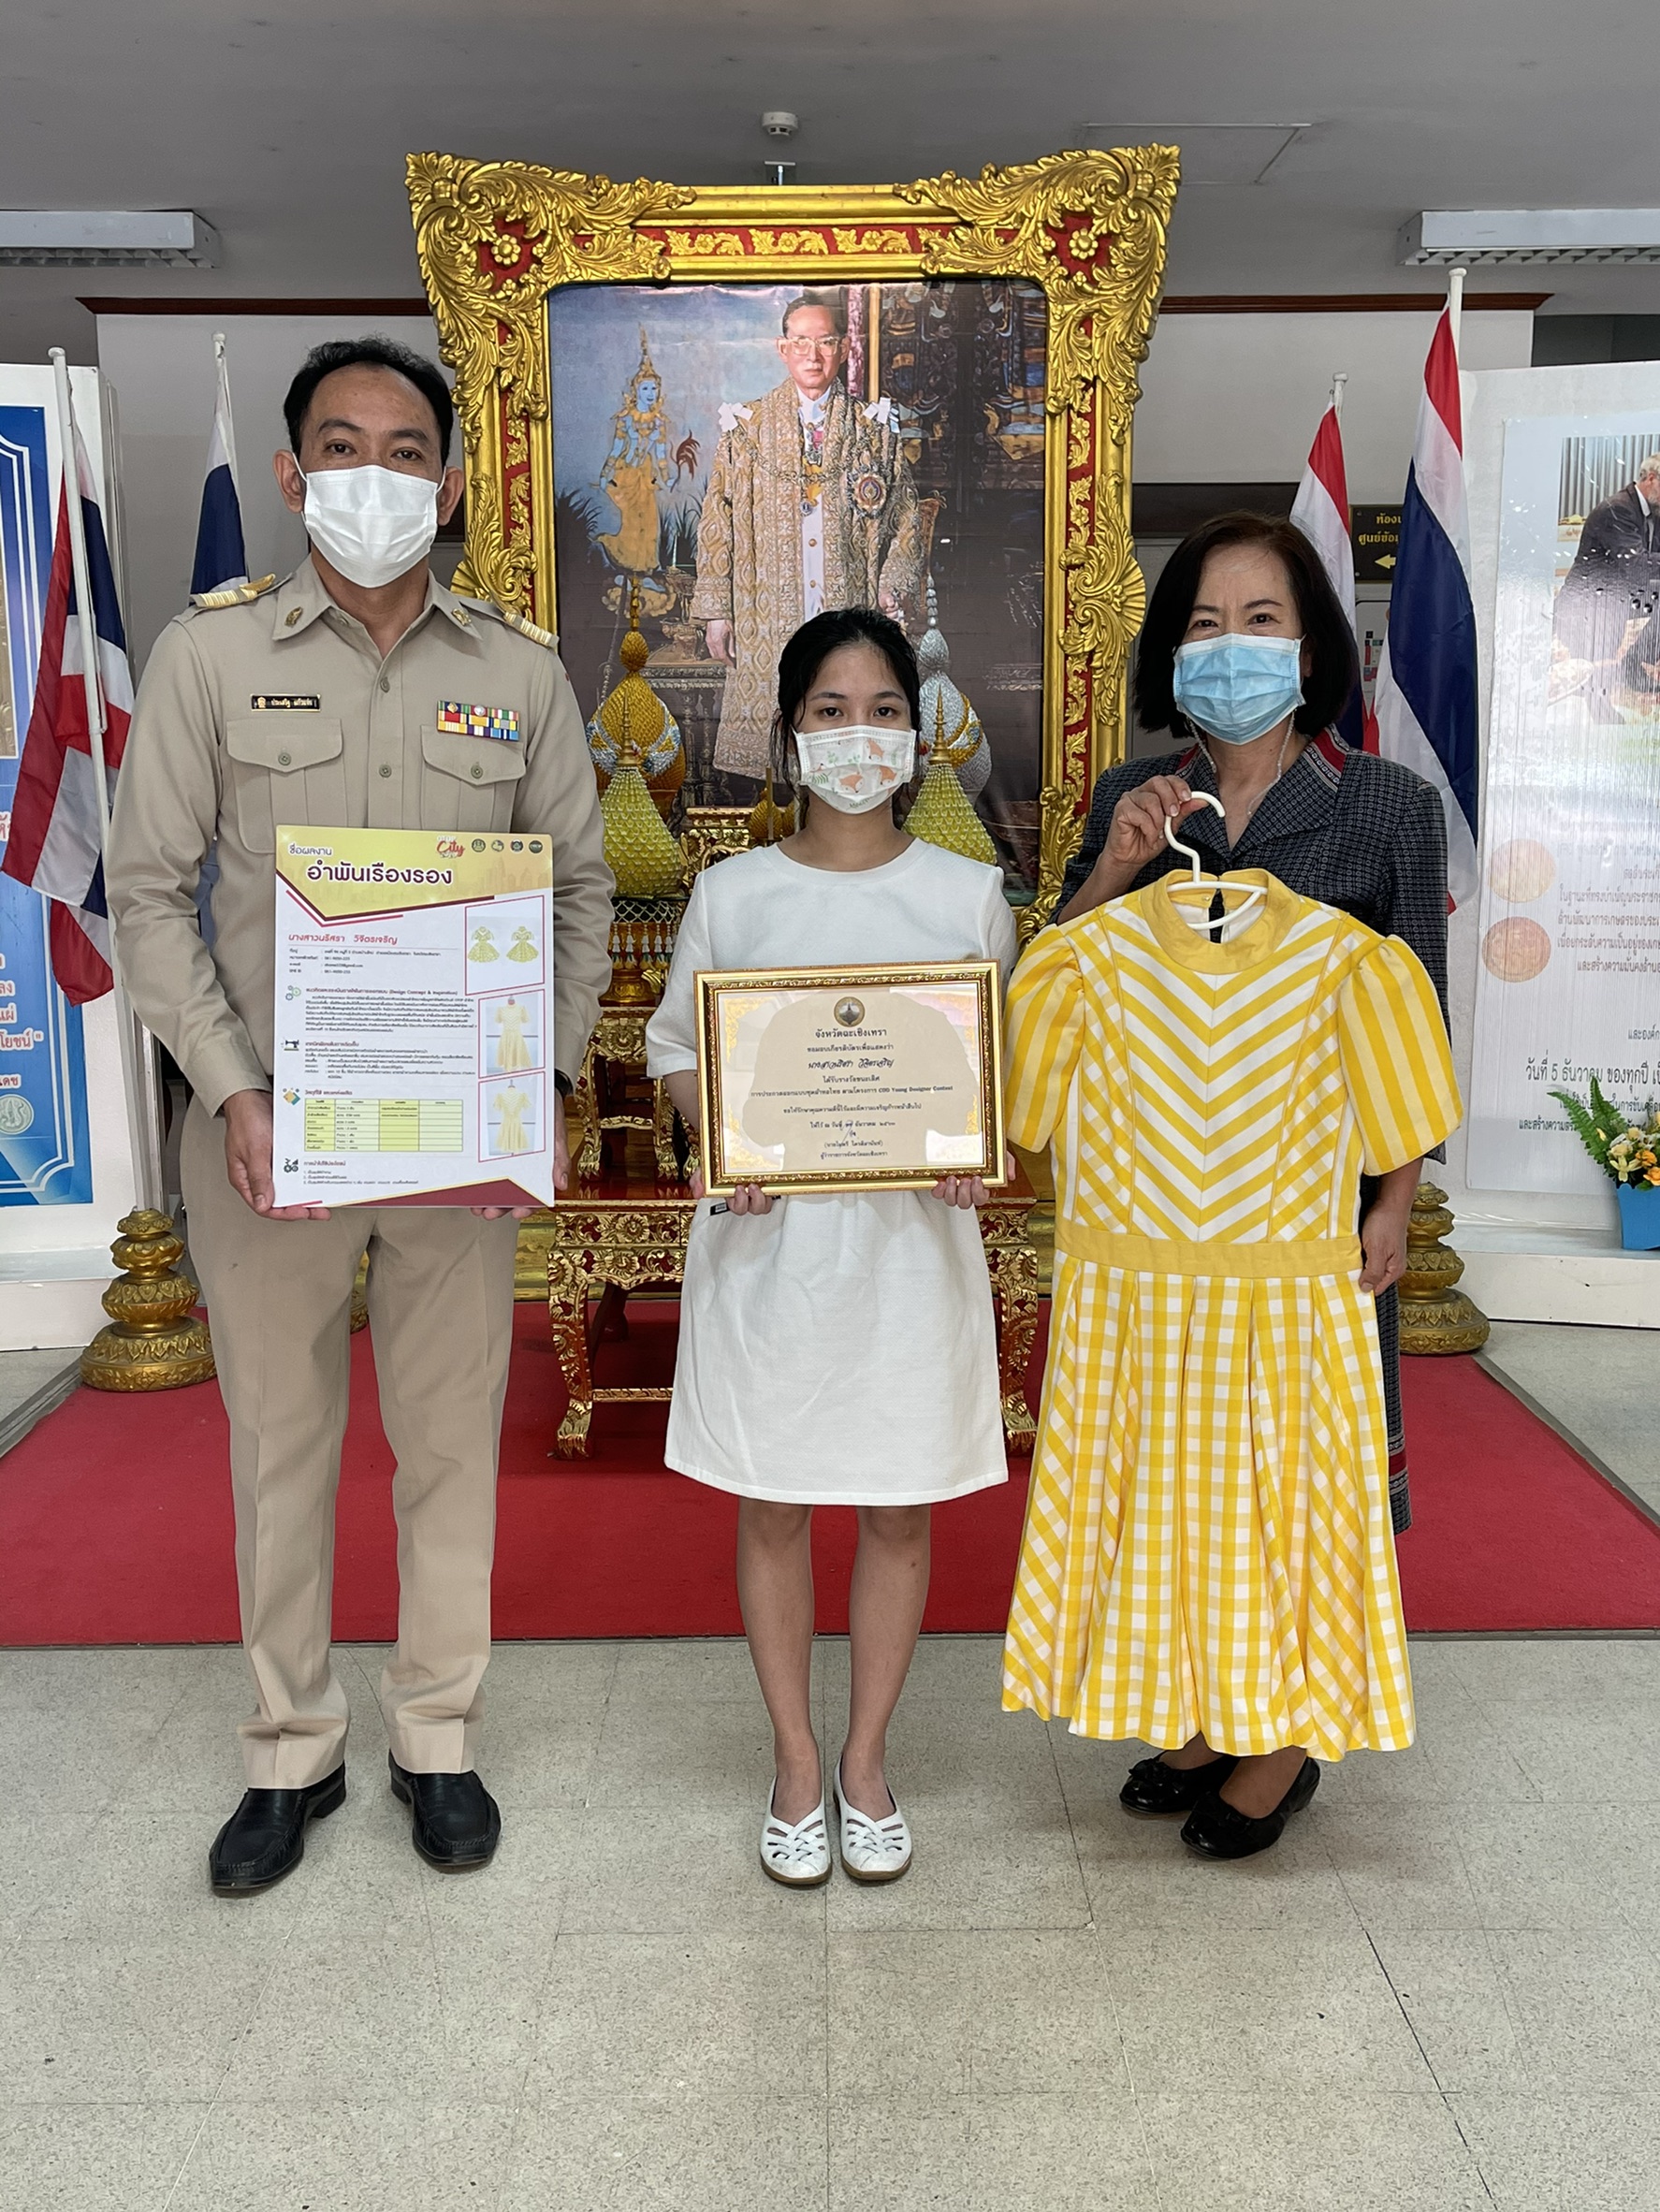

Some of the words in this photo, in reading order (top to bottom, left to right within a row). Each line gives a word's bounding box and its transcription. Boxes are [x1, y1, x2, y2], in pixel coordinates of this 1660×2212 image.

[288, 842, 333, 856] ชื่อผลงาน
[436, 839, 466, 858] City
[306, 859, 453, 885] อำพันเรืองรอง
[815, 1027, 888, 1039] จังหวัดฉะเชิงเทรา
[1525, 1049, 1549, 1082] วันที่
[1551, 1062, 1559, 1082] 5
[1607, 1060, 1650, 1094] ของทุกปี
